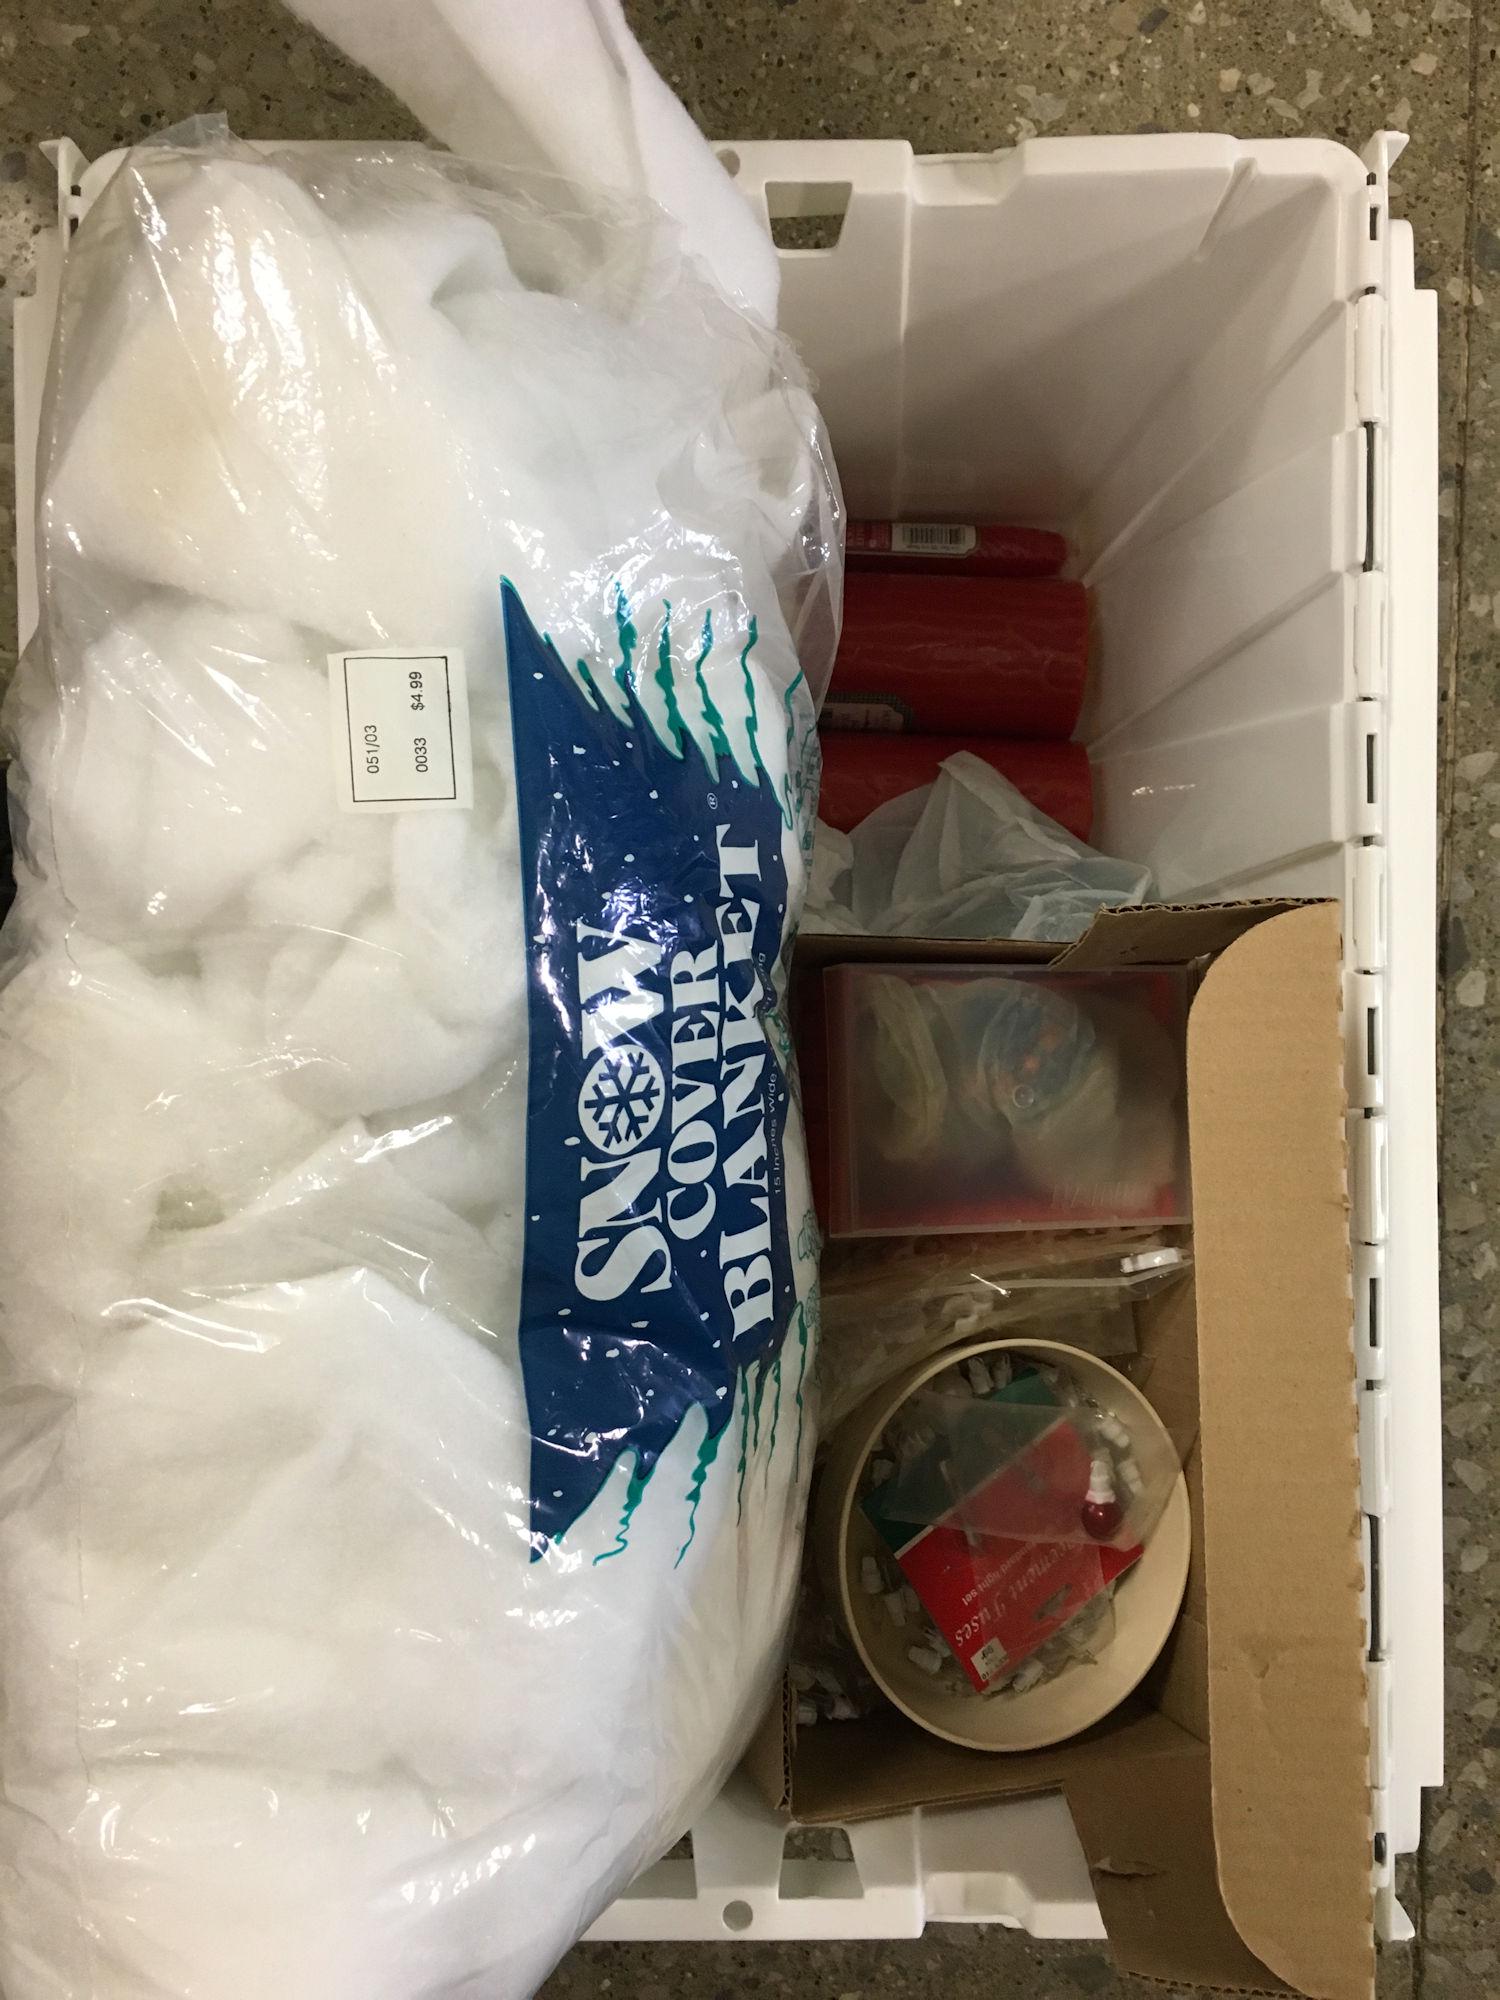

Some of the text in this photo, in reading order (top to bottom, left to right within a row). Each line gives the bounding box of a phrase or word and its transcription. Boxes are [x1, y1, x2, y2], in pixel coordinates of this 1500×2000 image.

[364, 724, 380, 774] 051/03
[408, 671, 429, 773] 0033 $4.99
[666, 939, 721, 1241] COVER
[715, 823, 774, 1342] BLANKET
[766, 1072, 779, 1114] Wide
